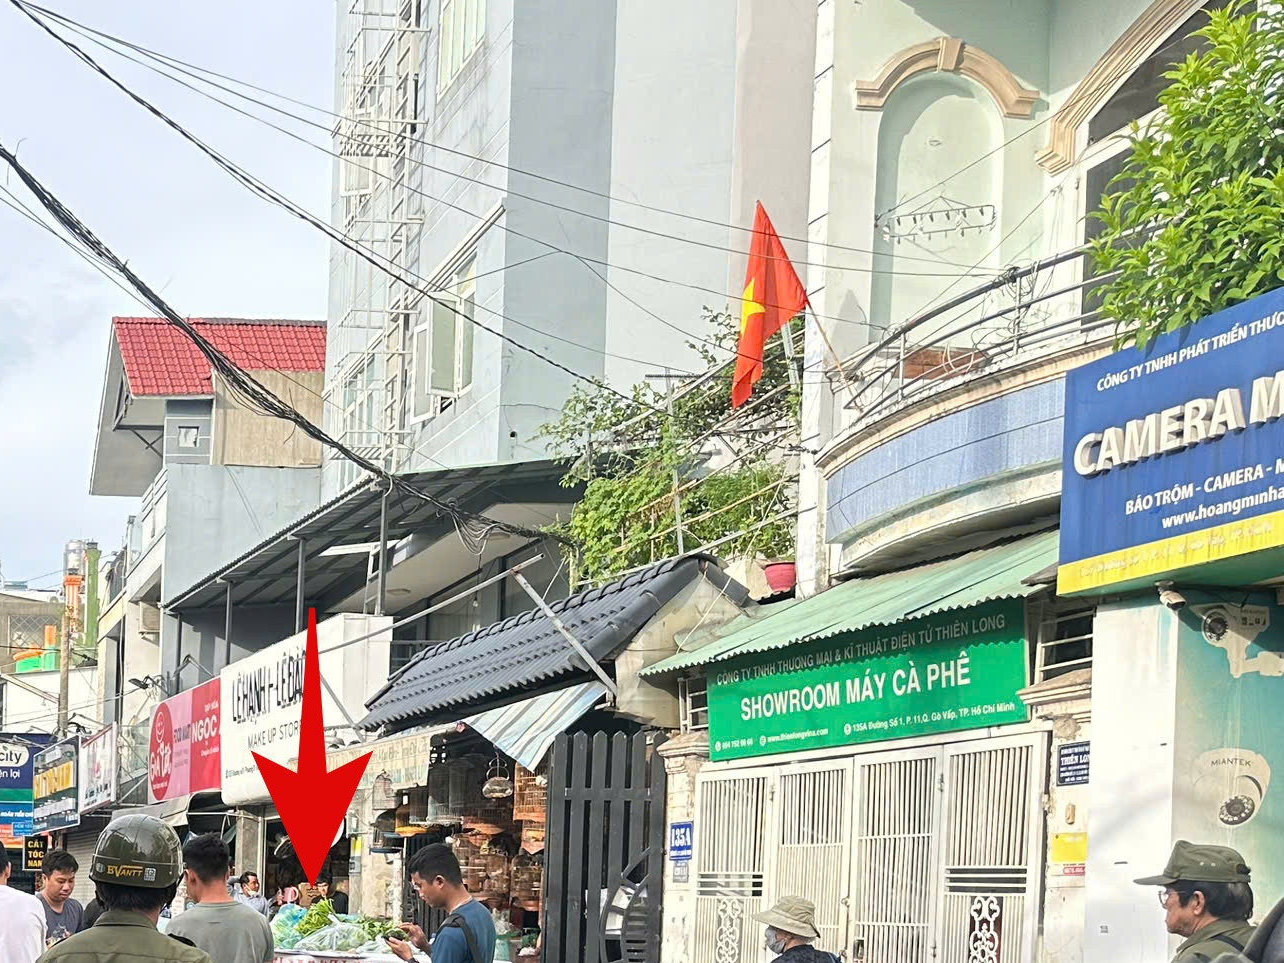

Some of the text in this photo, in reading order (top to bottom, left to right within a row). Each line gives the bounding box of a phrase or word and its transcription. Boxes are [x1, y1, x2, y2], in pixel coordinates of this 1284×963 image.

[1096, 369, 1128, 391] CÔNG
[1128, 362, 1148, 380] TY
[1145, 351, 1178, 374] TNHH
[1178, 337, 1211, 362] PHÁT
[1211, 322, 1248, 350] TRIỂN
[1073, 387, 1246, 477] CAMERA
[1125, 494, 1153, 515] BÁO
[1154, 482, 1194, 507] TRỘM
[1204, 464, 1264, 493] CAMERA
[716, 669, 739, 686] CÔNG
[740, 667, 752, 681] TY
[753, 663, 776, 679] TNHH
[855, 637, 888, 656] THUẬT
[891, 631, 916, 651] ĐIỆN
[935, 619, 969, 641] THIÊN
[972, 613, 1005, 633] LONG
[741, 650, 971, 721] SHOWROOM MÁY CÀ PHÊ
[247, 720, 301, 749] MAKE UP STOR
[1210, 757, 1252, 767] MIANTEK
[10, 768, 21, 779] lợi
